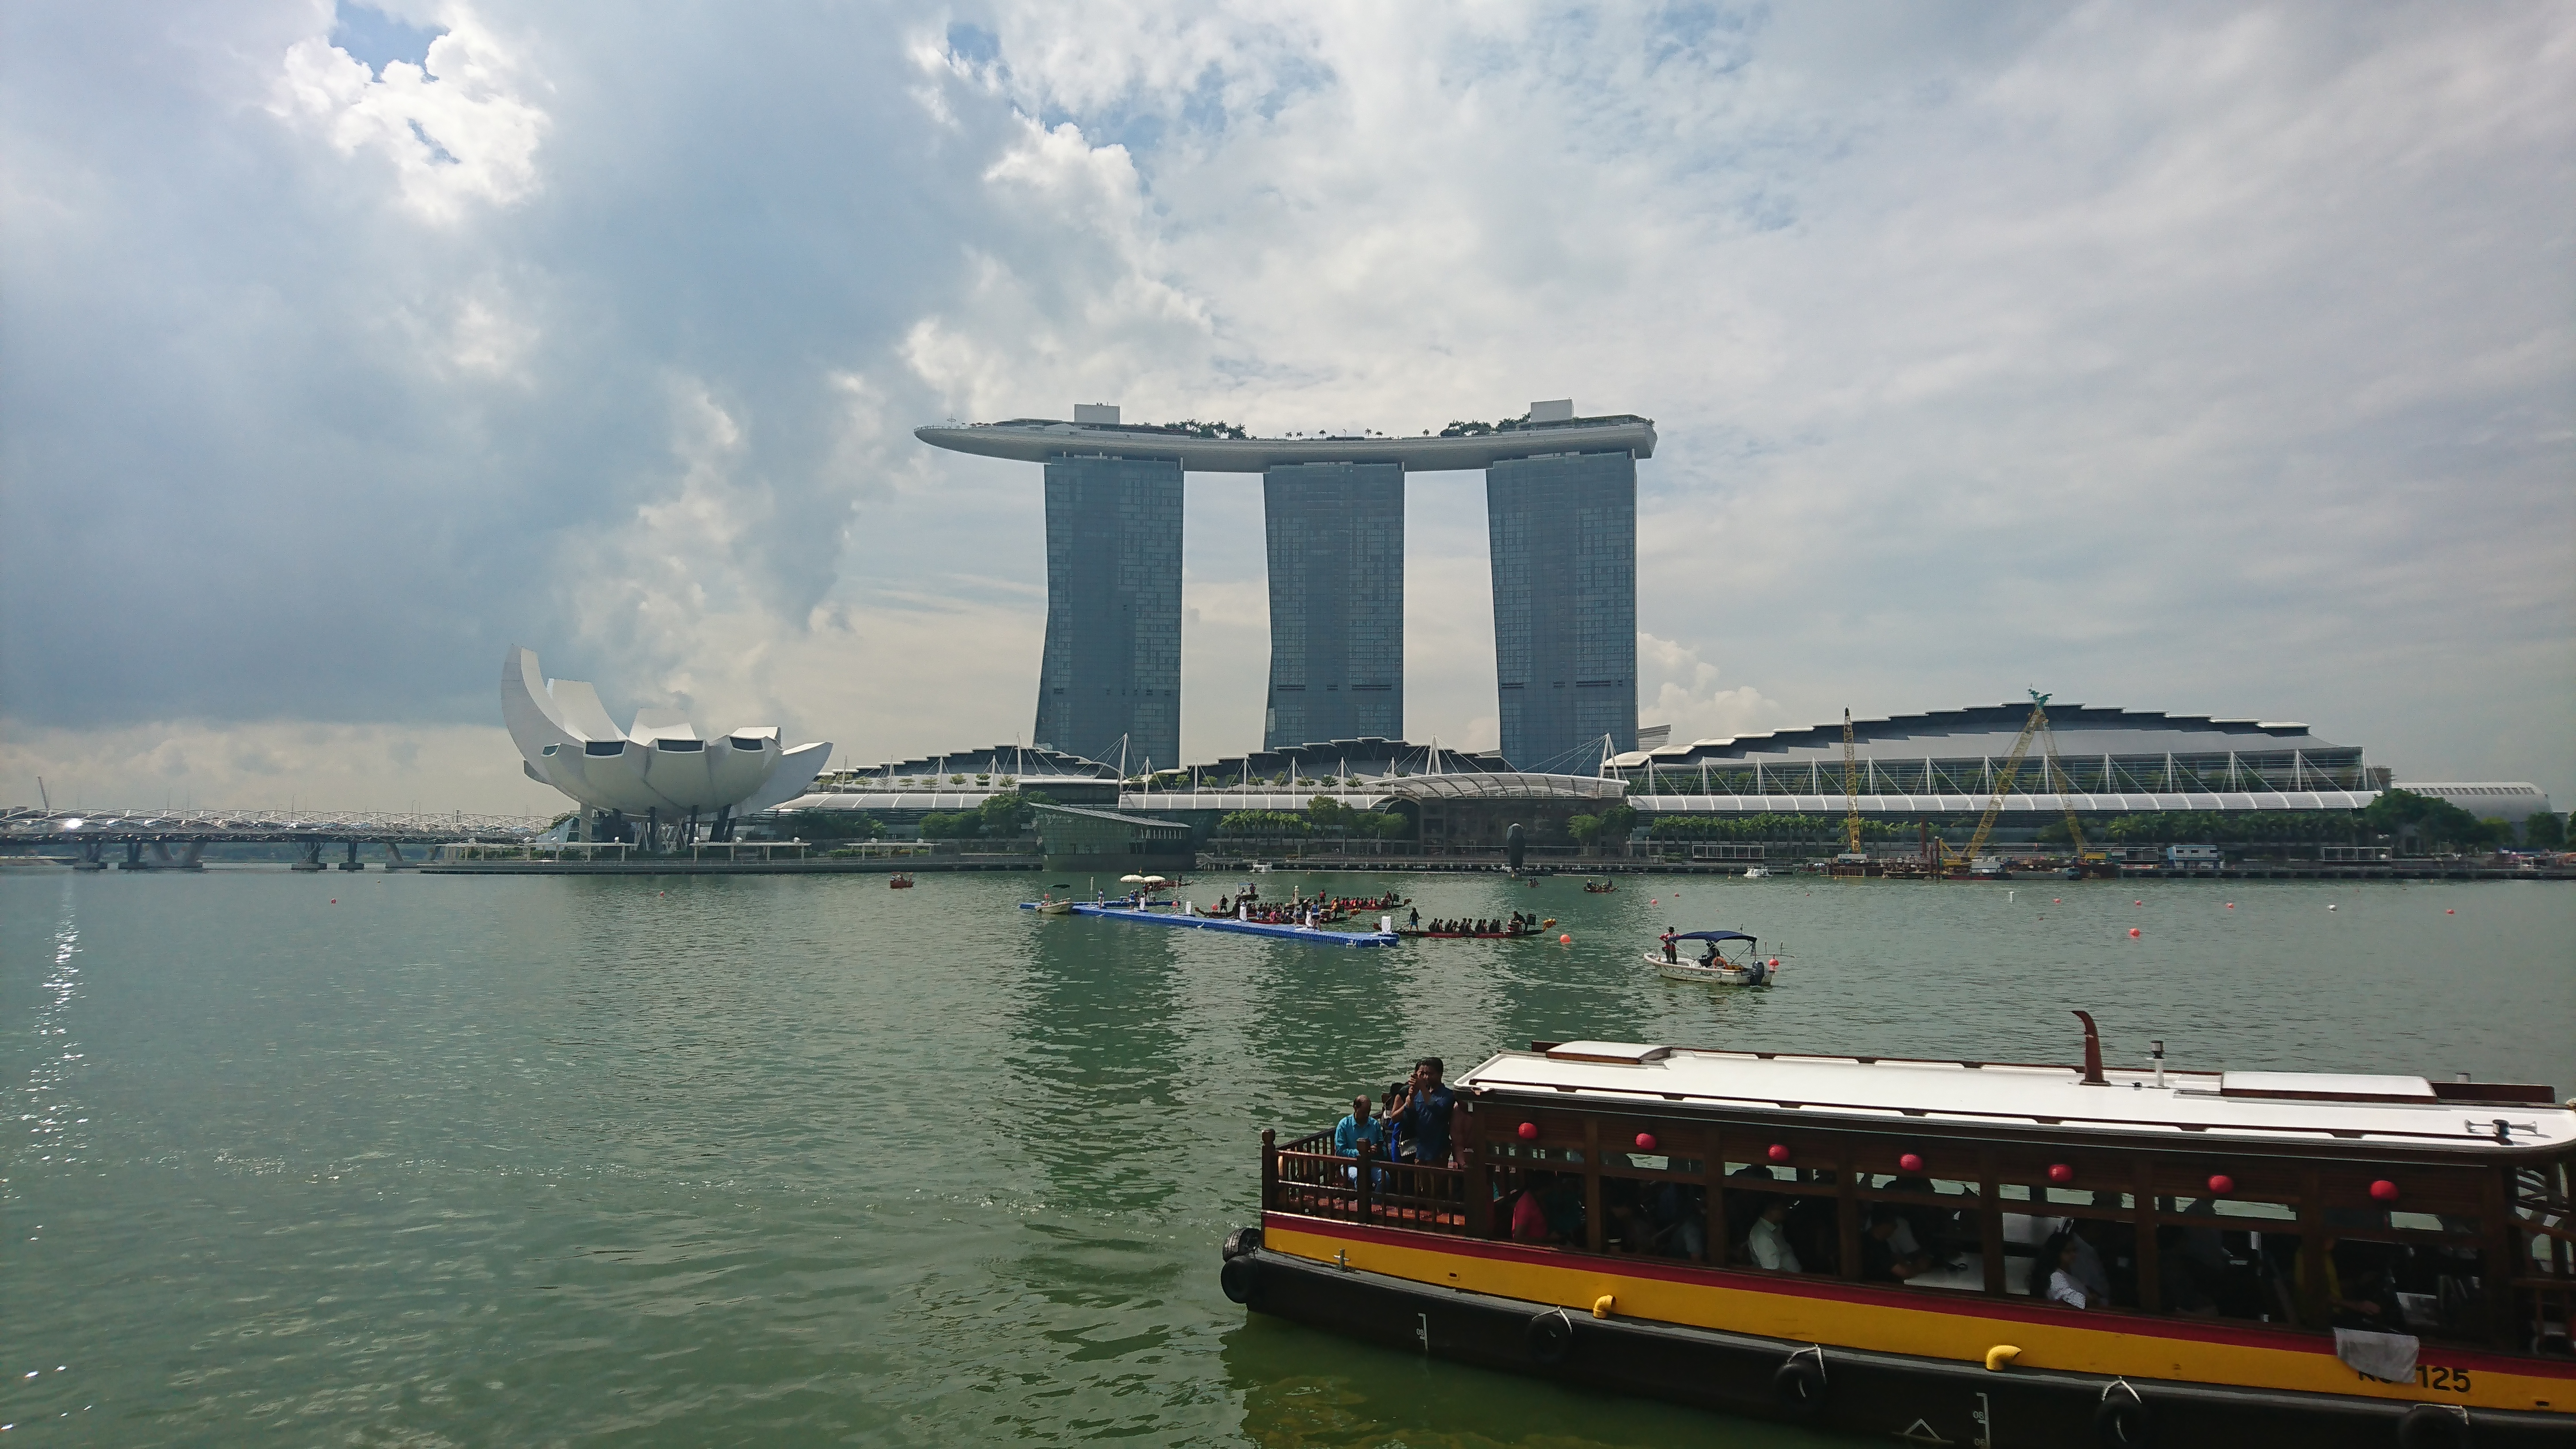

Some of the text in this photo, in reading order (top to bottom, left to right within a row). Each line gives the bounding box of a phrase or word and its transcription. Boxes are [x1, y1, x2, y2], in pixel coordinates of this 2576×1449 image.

[1416, 1328, 1424, 1336] 08
[2416, 1365, 2471, 1393] 125
[1973, 1411, 1984, 1420] 08
